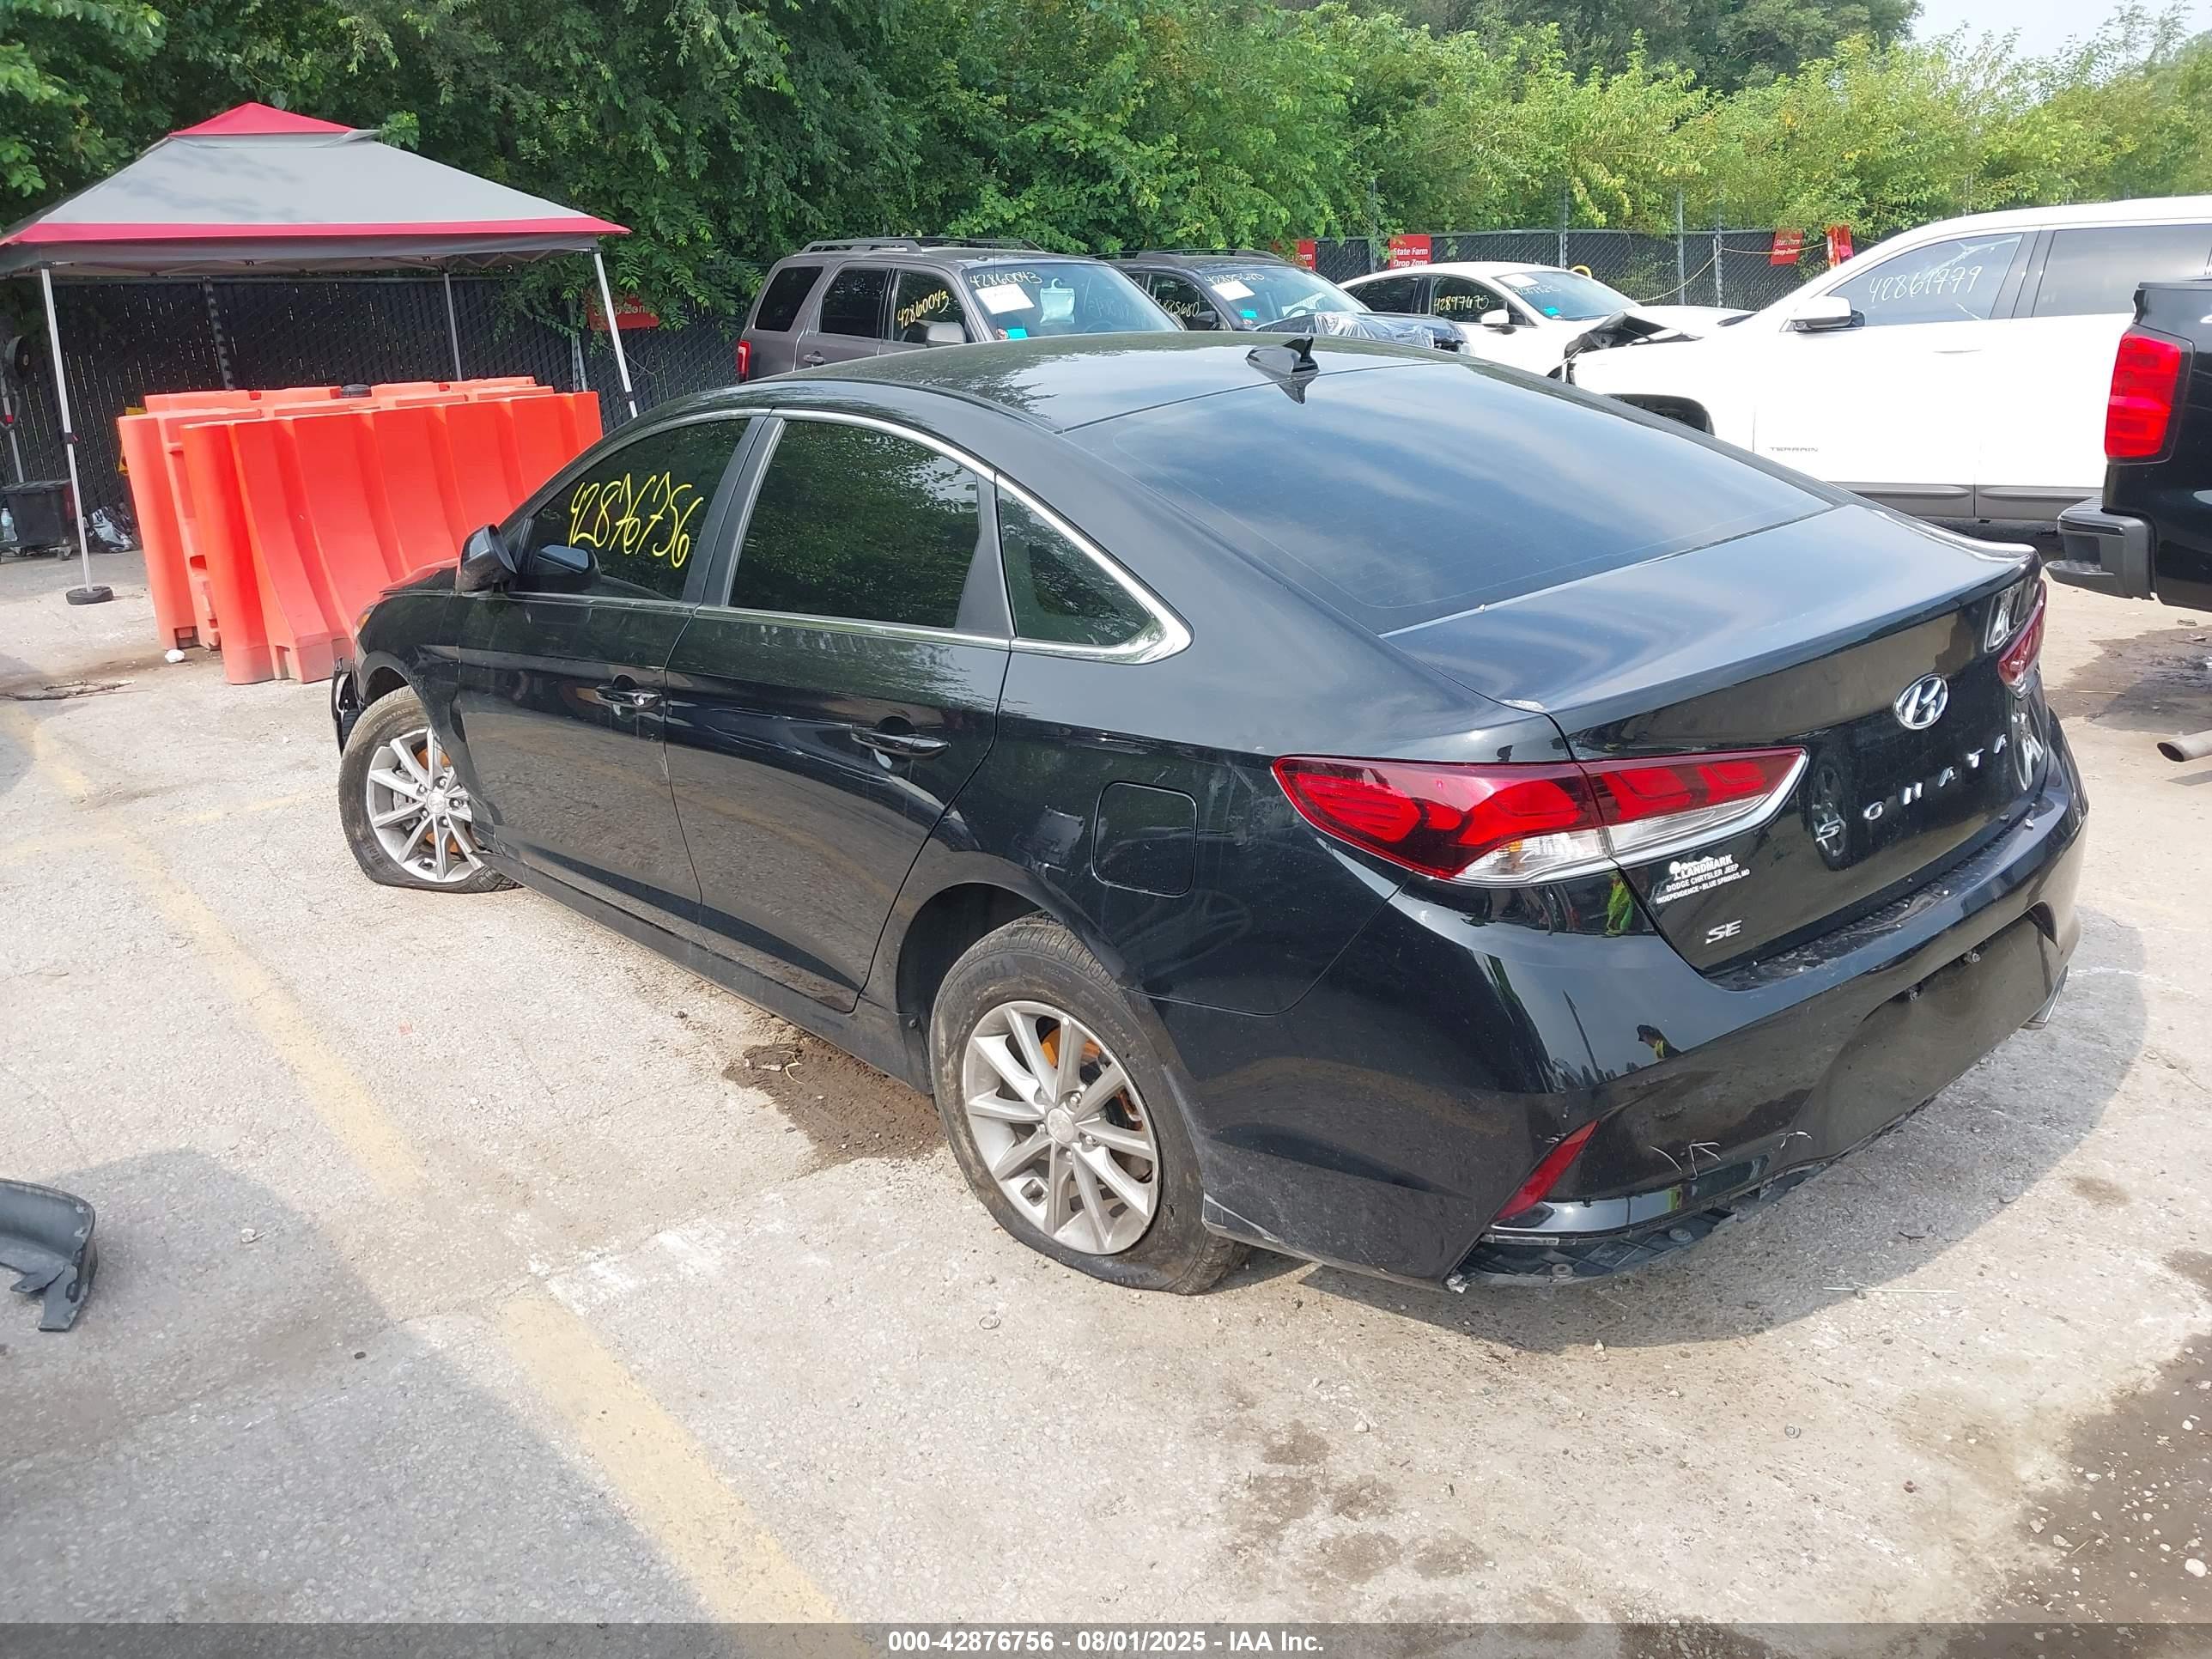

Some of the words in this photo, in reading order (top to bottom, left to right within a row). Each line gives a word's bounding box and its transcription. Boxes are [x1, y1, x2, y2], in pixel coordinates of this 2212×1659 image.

[1393, 247, 1410, 256] State
[1412, 246, 1429, 255] Farm
[1394, 259, 1410, 268] Drop
[1411, 258, 1428, 268] Zone
[969, 271, 1042, 288] 42860043
[897, 289, 950, 329] 42860043
[568, 471, 703, 568] 42876756
[1815, 733, 2008, 843] SONATA
[1666, 879, 1691, 893] DODGE
[1690, 868, 1723, 884] CHRYSLER
[1723, 863, 1739, 874] JEEP
[1680, 854, 1734, 879] LANDMARK
[1656, 885, 1699, 904] INDEPENDENCE
[1702, 880, 1717, 891] BLUE
[1741, 868, 1751, 878] MO
[1705, 919, 1742, 944] SE
